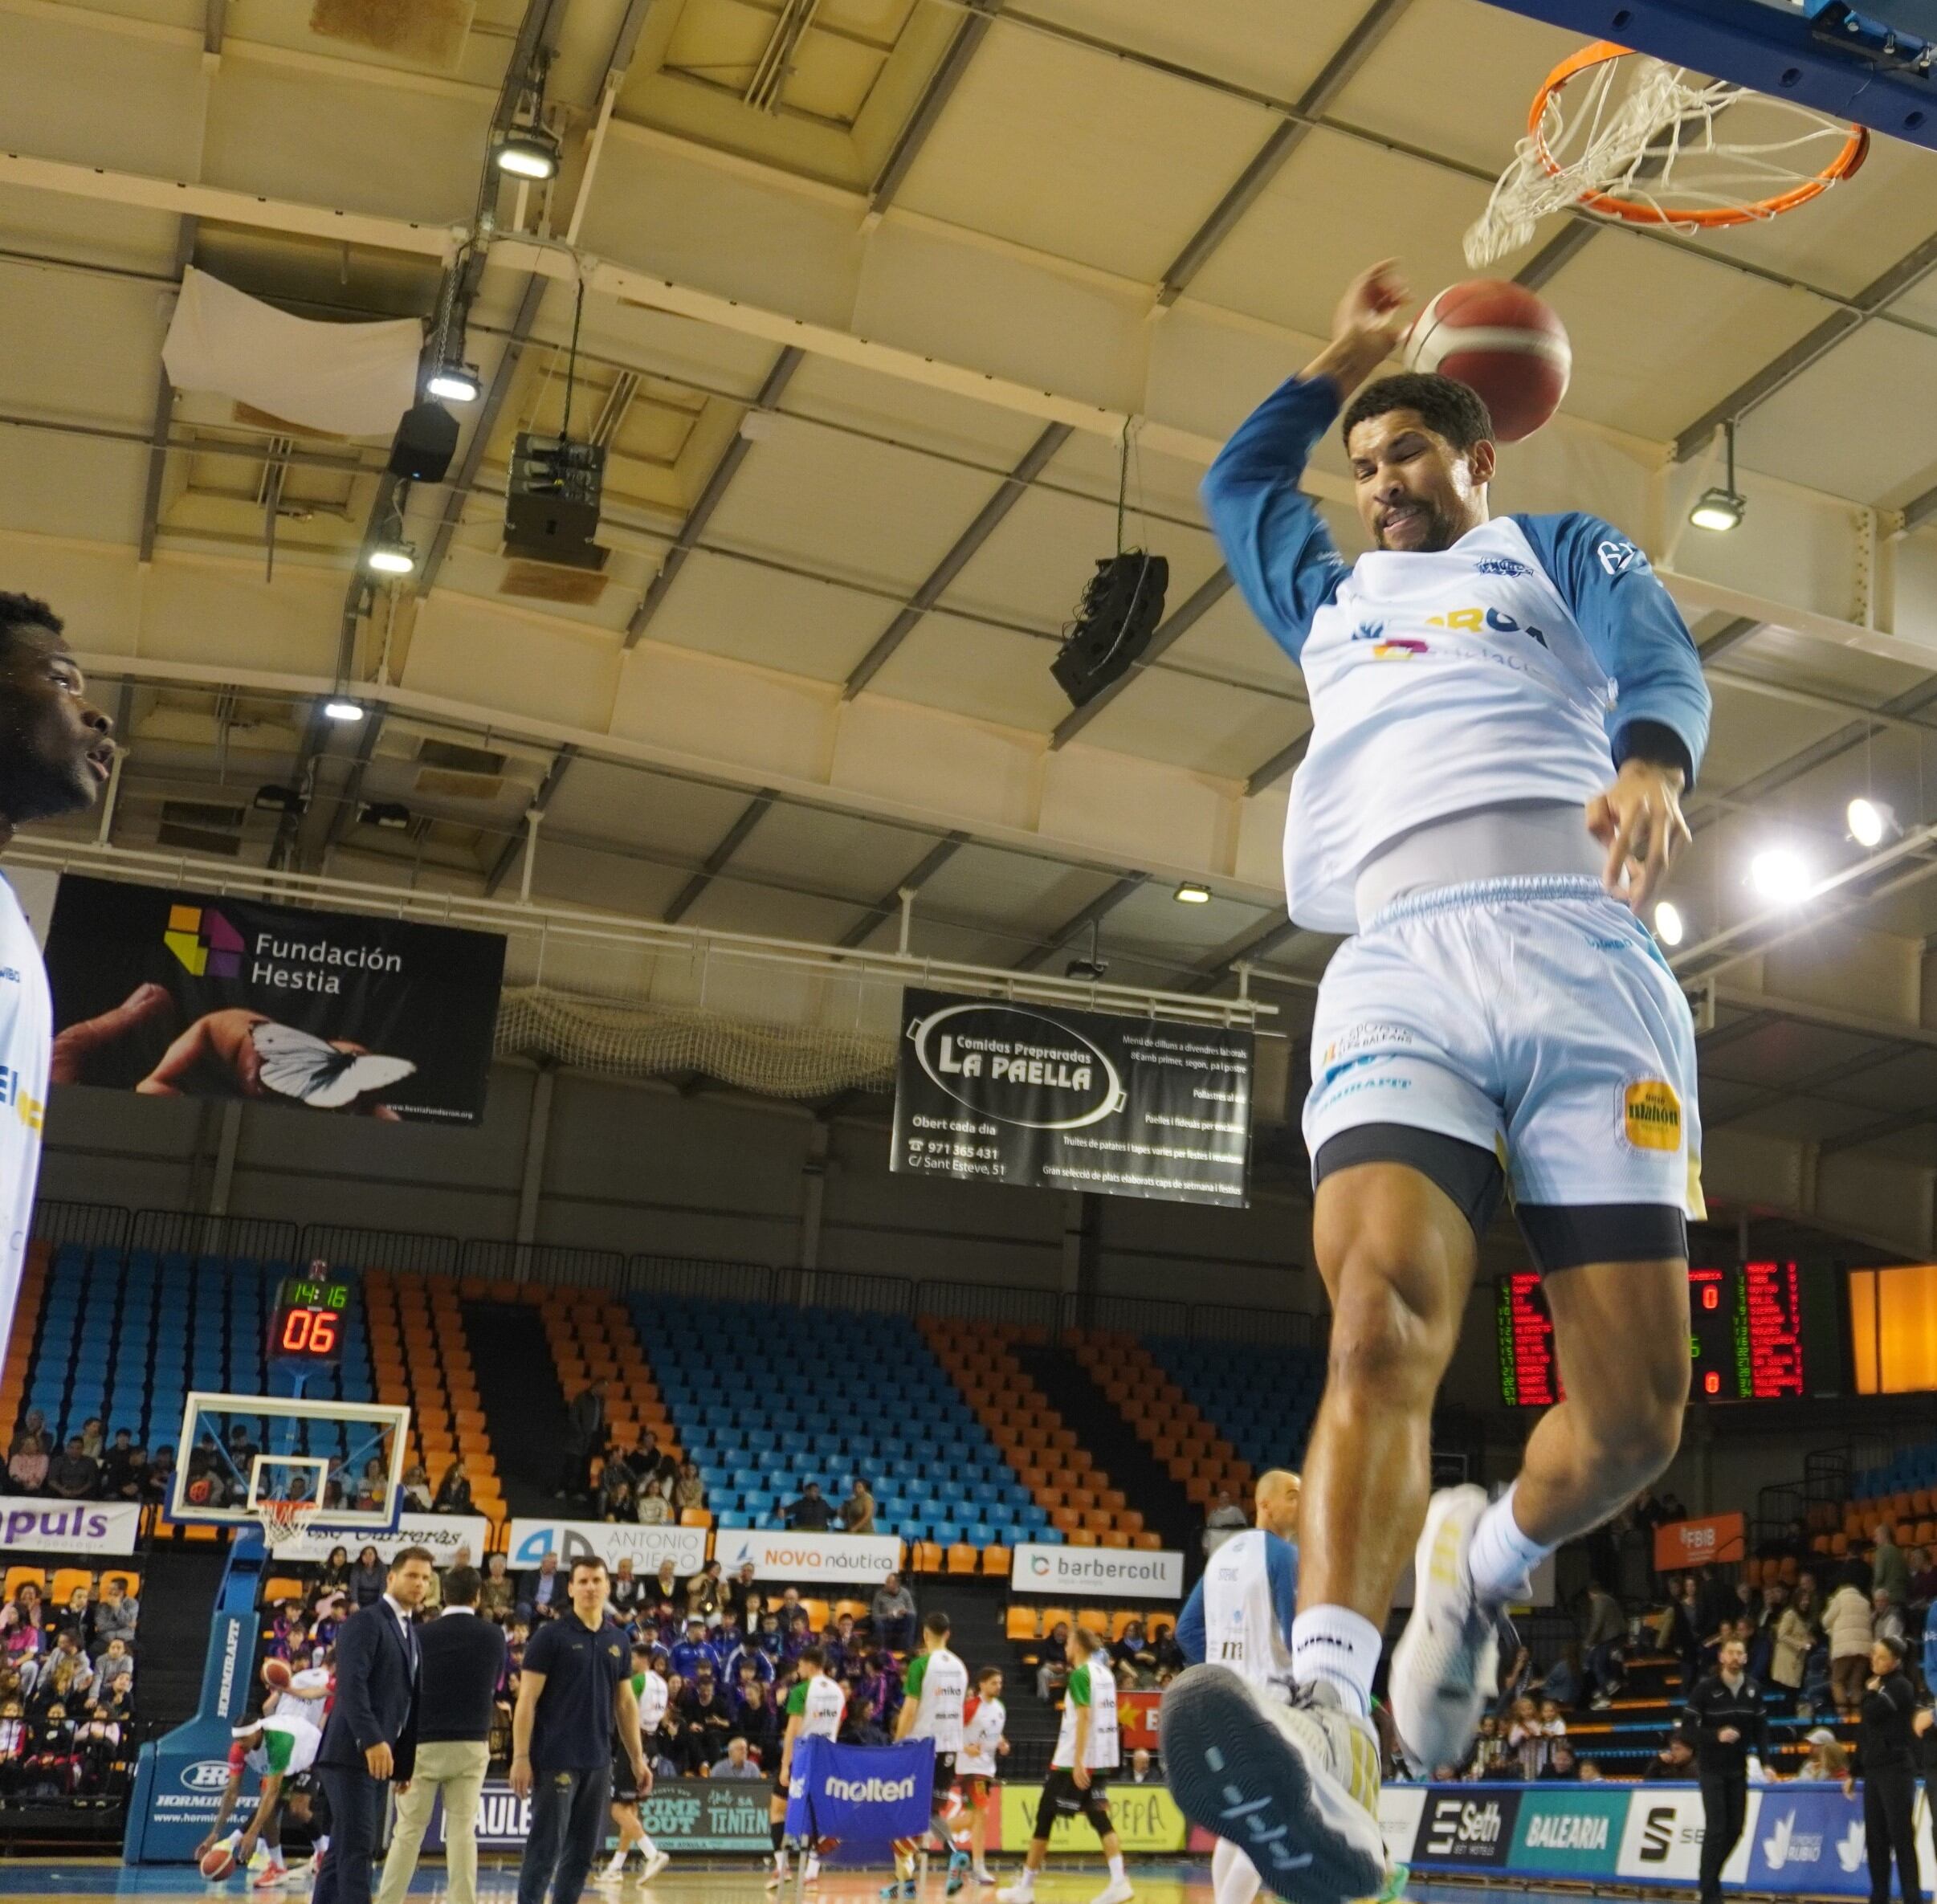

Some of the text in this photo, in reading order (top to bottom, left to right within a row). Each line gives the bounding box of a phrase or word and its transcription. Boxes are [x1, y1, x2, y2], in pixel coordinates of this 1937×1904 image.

[255, 933, 402, 972] Fundación
[251, 962, 341, 995] Hestia
[956, 1036, 1010, 1054] Comidas
[939, 1035, 1093, 1092] LA PAELLA
[912, 1115, 997, 1135] Obert cada dia
[928, 1142, 998, 1160] 971 365 431
[1088, 1139, 1099, 1149] de
[908, 1155, 922, 1167] C/
[924, 1157, 950, 1169] Sant
[992, 1165, 1005, 1176] 51
[1042, 1165, 1061, 1176] Gran
[1091, 1169, 1102, 1180] de
[1102, 1170, 1120, 1184] plats
[295, 1284, 347, 1307] 14:16
[1703, 1285, 1719, 1309] 0
[283, 1309, 338, 1353] 06
[1705, 1372, 1720, 1393] 0
[0, 1505, 108, 1544] puls
[608, 1530, 699, 1550] ANTONIO
[606, 1550, 618, 1566] Y
[825, 1550, 893, 1571] náutica
[1058, 1556, 1167, 1581] barbercoll
[217, 1617, 241, 1720] HORMIRAPIT
[825, 1775, 915, 1803] molten
[156, 1795, 263, 1808] HORMIRPIT
[642, 1816, 695, 1835] OUT
[1458, 1801, 1502, 1842] Seth
